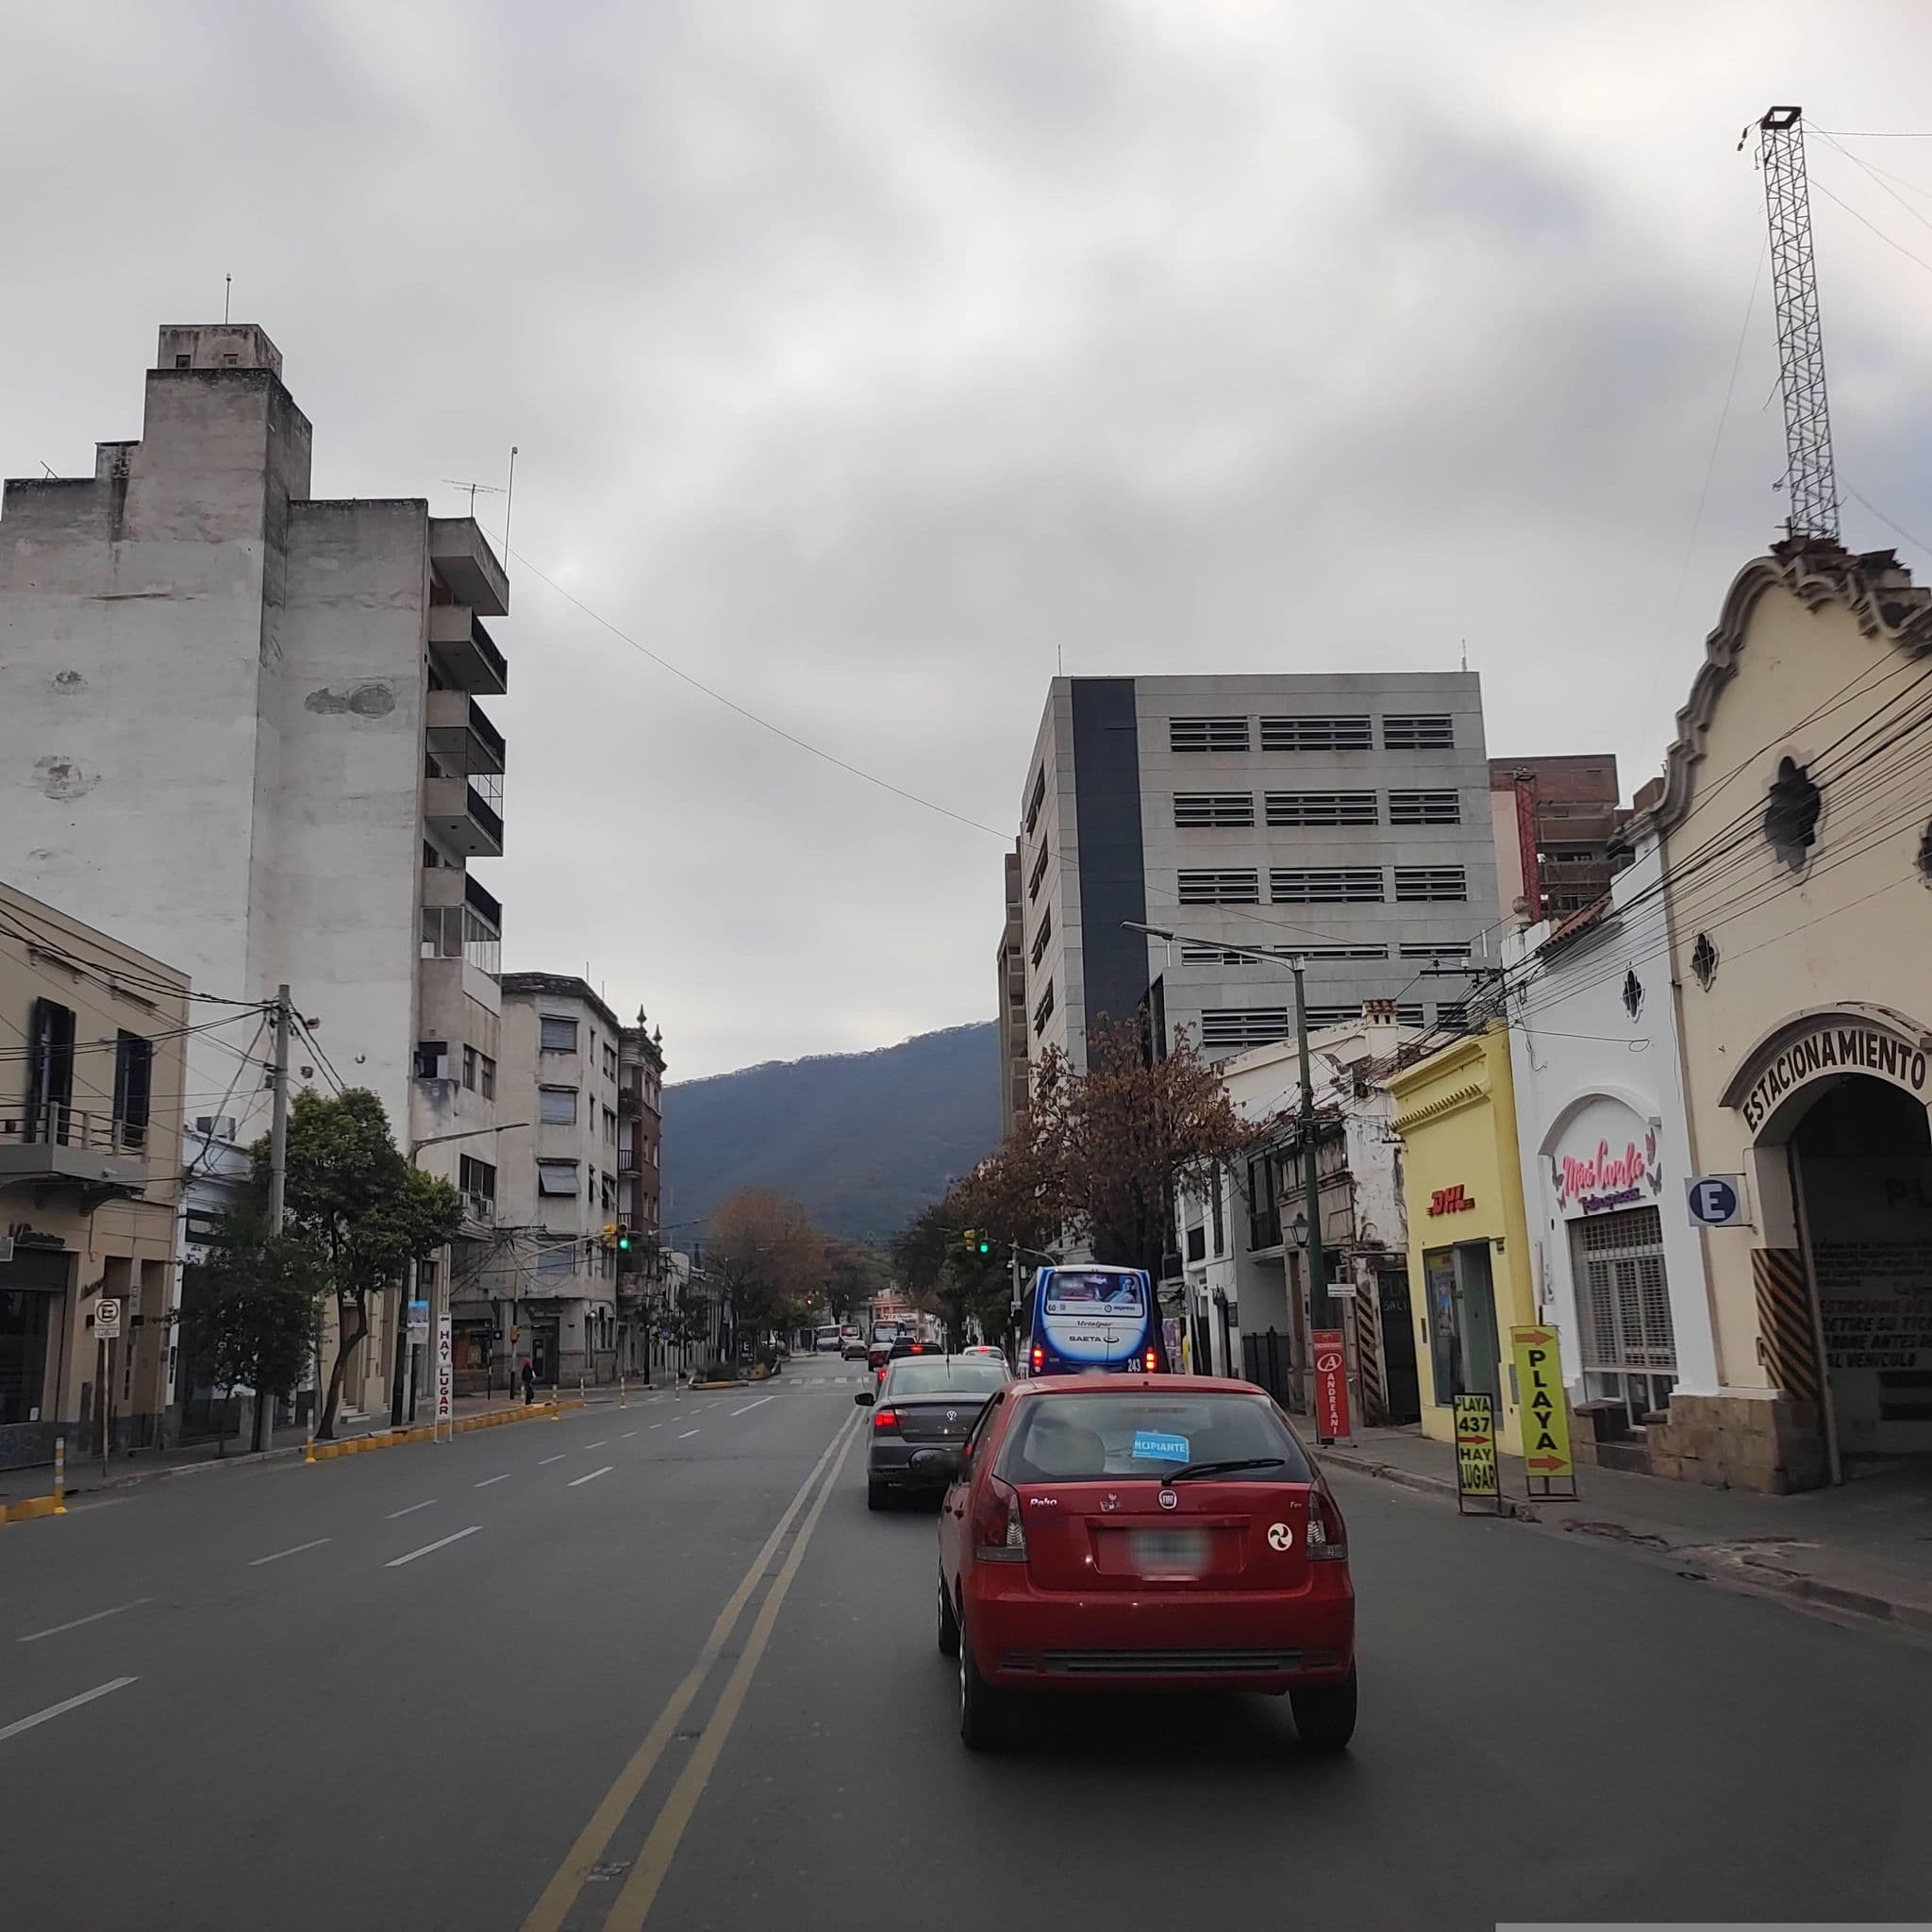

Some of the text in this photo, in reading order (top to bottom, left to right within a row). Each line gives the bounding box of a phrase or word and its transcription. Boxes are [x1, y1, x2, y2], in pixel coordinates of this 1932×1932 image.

[1742, 1030, 1925, 1134] ESTACIONAMIENTO
[1429, 1184, 1470, 1216] DHL
[1700, 1183, 1725, 1220] E
[102, 1304, 113, 1320] E
[1048, 1304, 1057, 1312] 60
[439, 1330, 450, 1415] HAY LUGAR
[1127, 1358, 1141, 1372] 243
[1326, 1373, 1339, 1435] ANDREANI
[1456, 1397, 1491, 1412] PLAYA
[1528, 1350, 1557, 1450] PLAYA
[1459, 1417, 1490, 1432] 437
[1460, 1448, 1491, 1460] HAY
[1460, 1464, 1495, 1489] LUGAR
[1030, 1497, 1058, 1508] Palio
